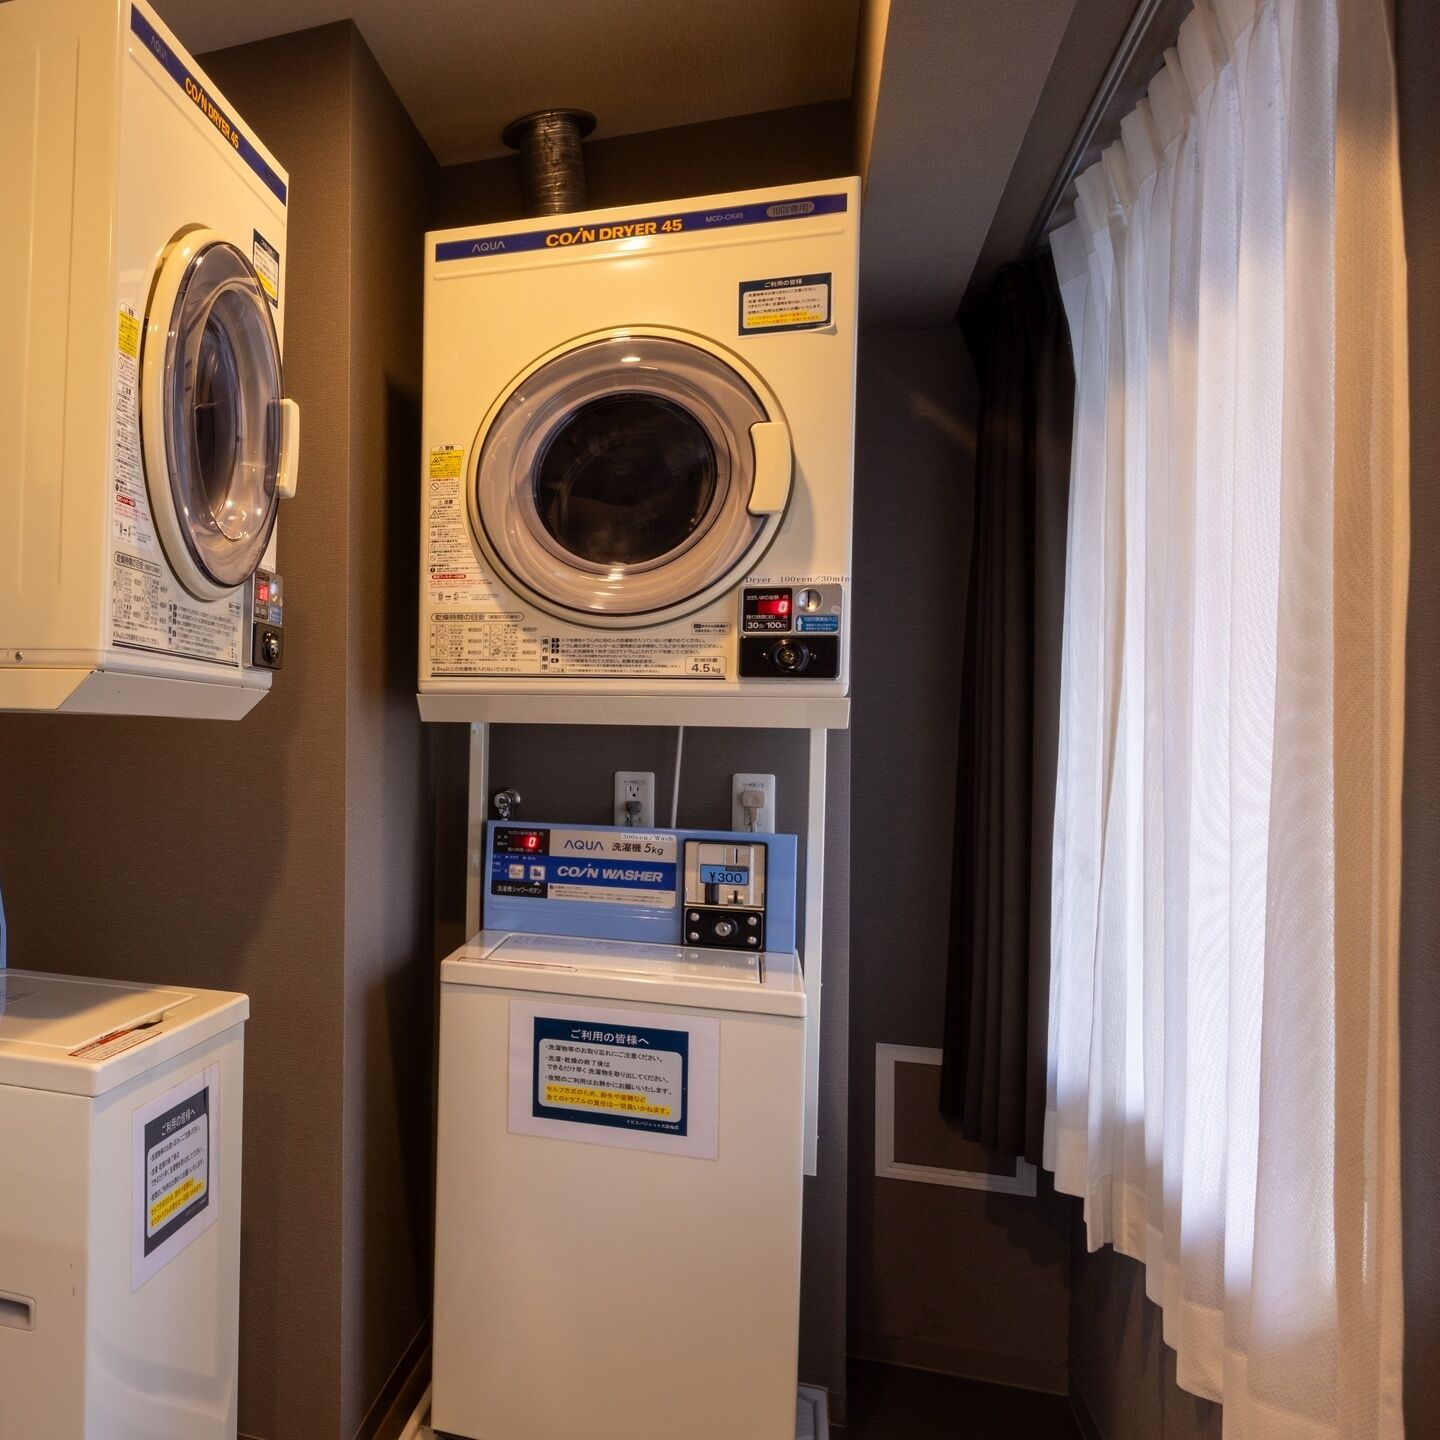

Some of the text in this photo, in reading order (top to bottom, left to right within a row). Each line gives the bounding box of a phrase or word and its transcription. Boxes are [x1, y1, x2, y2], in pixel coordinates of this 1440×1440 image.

[208, 102, 231, 141] DRYER
[230, 132, 240, 150] 45
[599, 220, 657, 242] DRYER
[661, 218, 683, 233] 45
[471, 240, 506, 253] AQUA
[778, 601, 788, 613] 0
[691, 663, 711, 673] 4.5
[528, 836, 537, 847] 0
[564, 839, 664, 855] AQUA 洗濯機 5kg
[602, 868, 664, 882] WASHER
[708, 871, 743, 884] ¥300
[570, 1029, 649, 1045] ご利用の皆様へ
